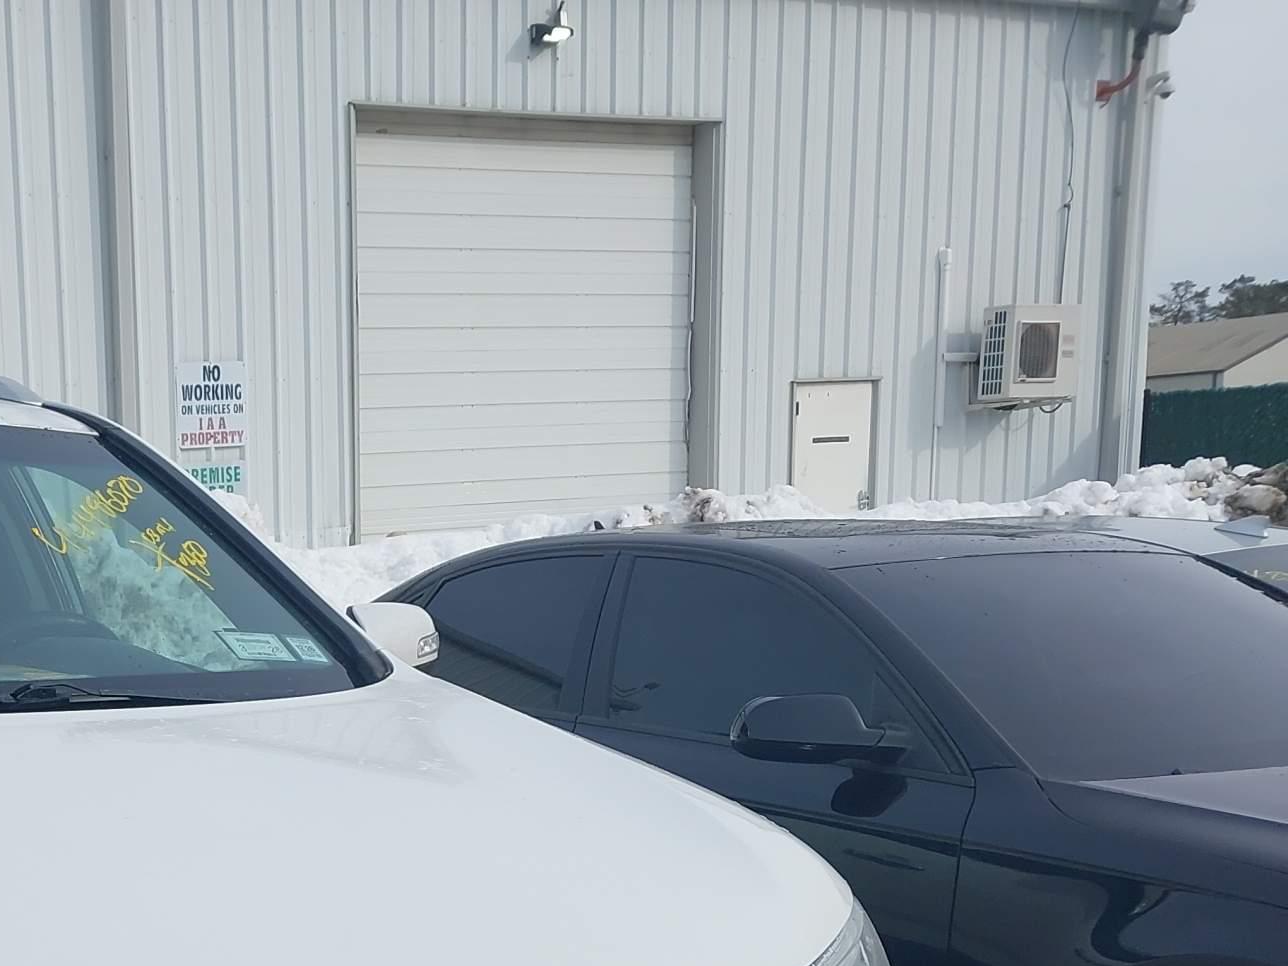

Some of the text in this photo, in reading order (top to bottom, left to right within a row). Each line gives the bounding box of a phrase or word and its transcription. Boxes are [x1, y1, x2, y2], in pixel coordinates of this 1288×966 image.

[202, 365, 221, 382] NO
[181, 384, 242, 401] WORKING
[181, 403, 244, 415] ON VEHICLES ON
[181, 430, 244, 446] PROPERTY
[187, 466, 241, 484] REMISE
